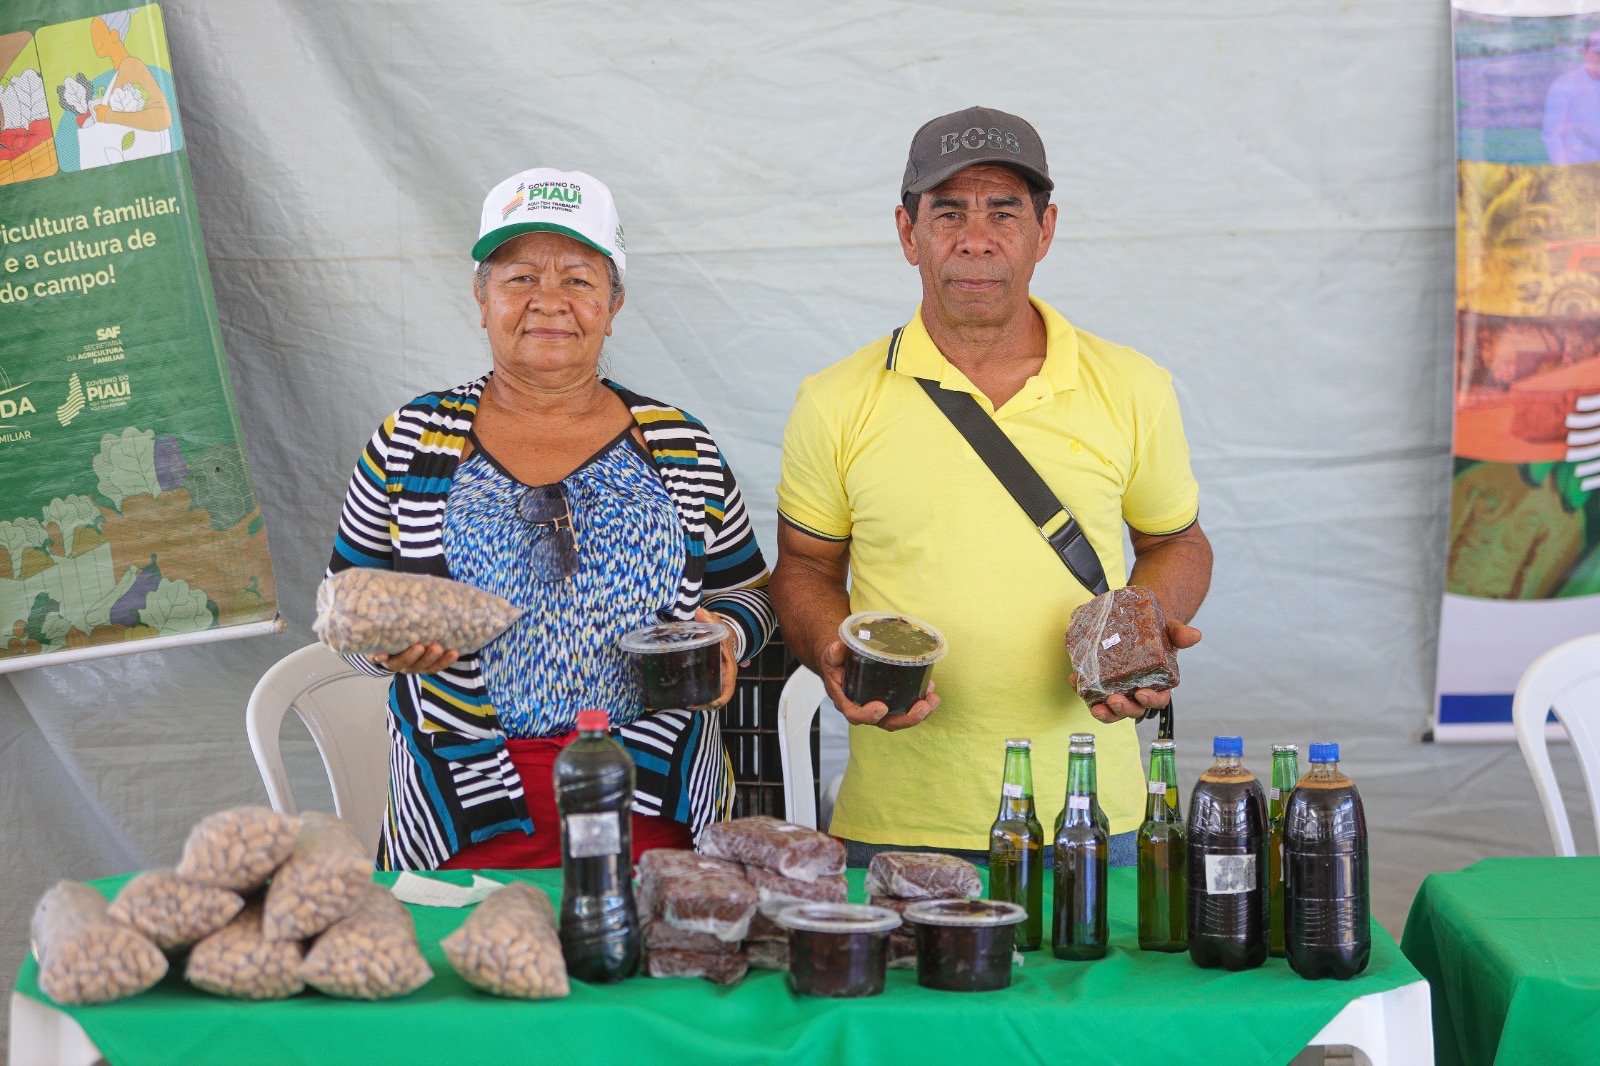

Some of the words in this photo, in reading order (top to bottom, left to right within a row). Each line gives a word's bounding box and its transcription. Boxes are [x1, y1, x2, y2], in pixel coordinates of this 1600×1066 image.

[528, 182, 568, 190] GOVERNO
[570, 183, 581, 192] DO
[0, 214, 90, 245] icultura
[93, 196, 181, 227] familiar,
[4, 258, 19, 273] e
[25, 254, 40, 270] a
[44, 239, 124, 266] cultura
[127, 228, 157, 251] de
[0, 282, 29, 304] do
[34, 264, 116, 297] campo!
[96, 325, 121, 341] SAF
[83, 339, 124, 352] SECRETARIA
[67, 354, 77, 362] DA
[77, 346, 124, 361] AGRICULTURA
[93, 353, 125, 364] FAMILIAR
[85, 376, 118, 388] GOVERNO
[118, 374, 130, 383] DO
